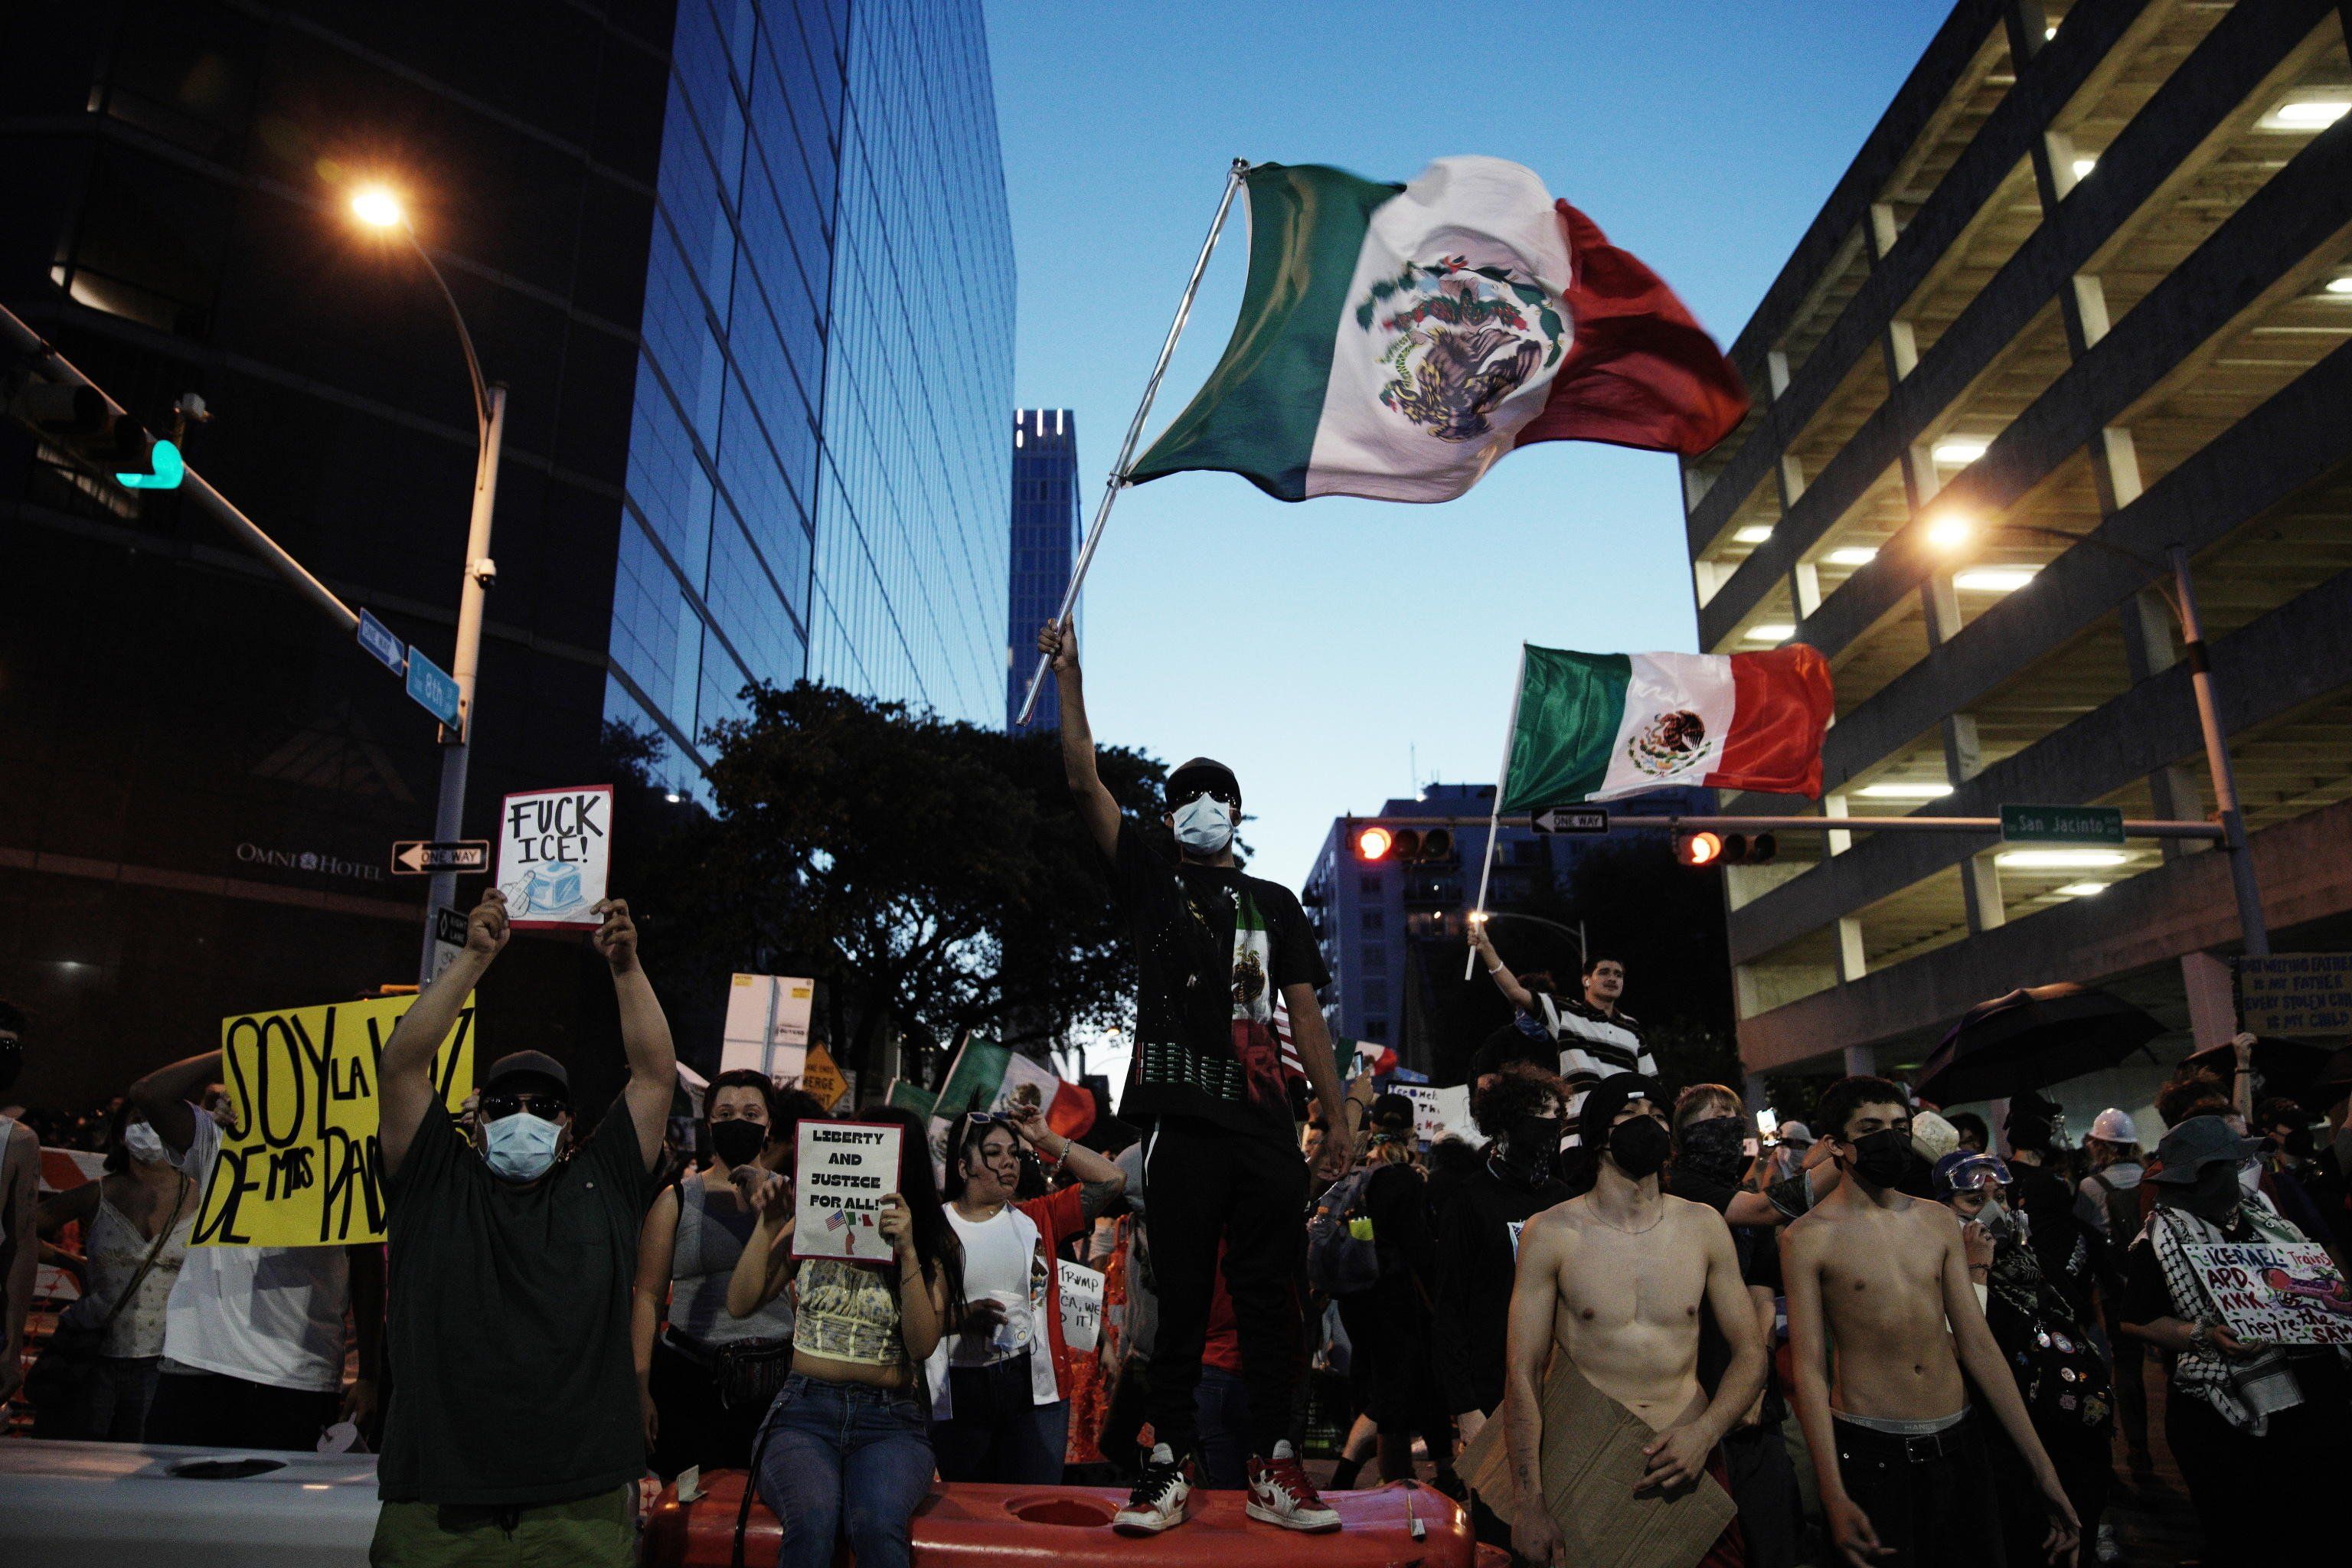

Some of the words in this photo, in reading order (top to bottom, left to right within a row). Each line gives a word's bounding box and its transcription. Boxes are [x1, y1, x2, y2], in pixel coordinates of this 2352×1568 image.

[425, 672, 443, 707] 8th
[508, 795, 604, 839] FUCK
[1554, 815, 1575, 827] ONE
[1578, 815, 1600, 827] WAY
[2019, 814, 2044, 832] San
[2053, 815, 2103, 834] Jacinto
[421, 850, 449, 864] ONE
[452, 850, 477, 864] WAY
[518, 835, 588, 864] ICE!
[2292, 973, 2344, 991] FATHER
[226, 1006, 336, 1148] SOY
[331, 1056, 371, 1100] LA
[812, 1129, 885, 1145] LIBERTY
[828, 1152, 862, 1166] AND
[811, 1173, 881, 1189] JUSTICE
[191, 1145, 268, 1245] DE
[809, 1194, 841, 1208] FOR
[844, 1197, 880, 1210] ALL!
[1057, 1264, 1099, 1293] TRUMP
[1084, 1302, 1100, 1315] WE
[2296, 1308, 2336, 1327] the
[2311, 1323, 2352, 1344] SAM
